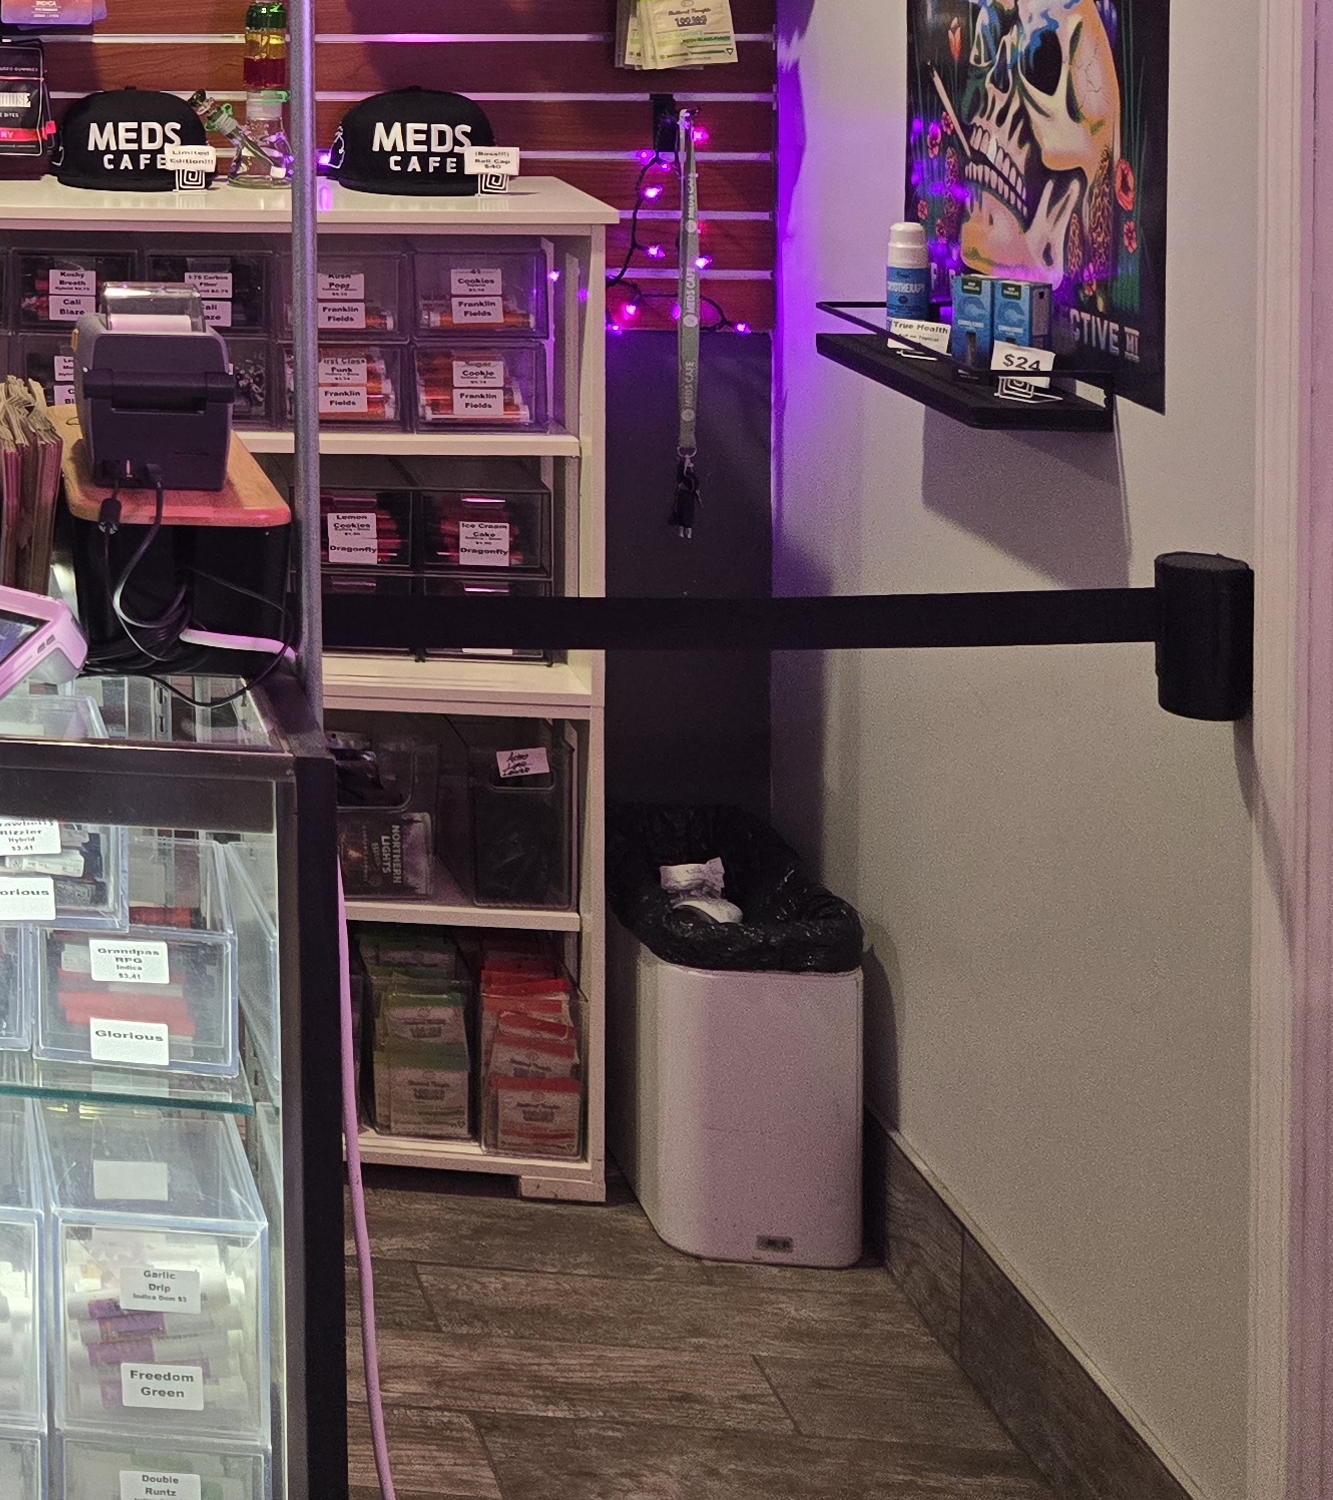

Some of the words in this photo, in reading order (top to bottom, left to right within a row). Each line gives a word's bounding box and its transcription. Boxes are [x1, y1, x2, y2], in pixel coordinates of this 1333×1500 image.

[87, 122, 181, 152] MEDS
[373, 123, 471, 152] MEDS
[103, 156, 166, 170] CAFE
[390, 157, 456, 172] CAFE
[893, 321, 914, 330] True
[917, 323, 948, 334] Health
[1003, 353, 1041, 371] $24
[144, 1270, 176, 1280] Garlic
[149, 1282, 171, 1294] Drip
[130, 1370, 194, 1383] Freedom
[141, 1386, 184, 1398] Green
[141, 1475, 179, 1485] Double
[145, 1486, 176, 1497] Runtz
